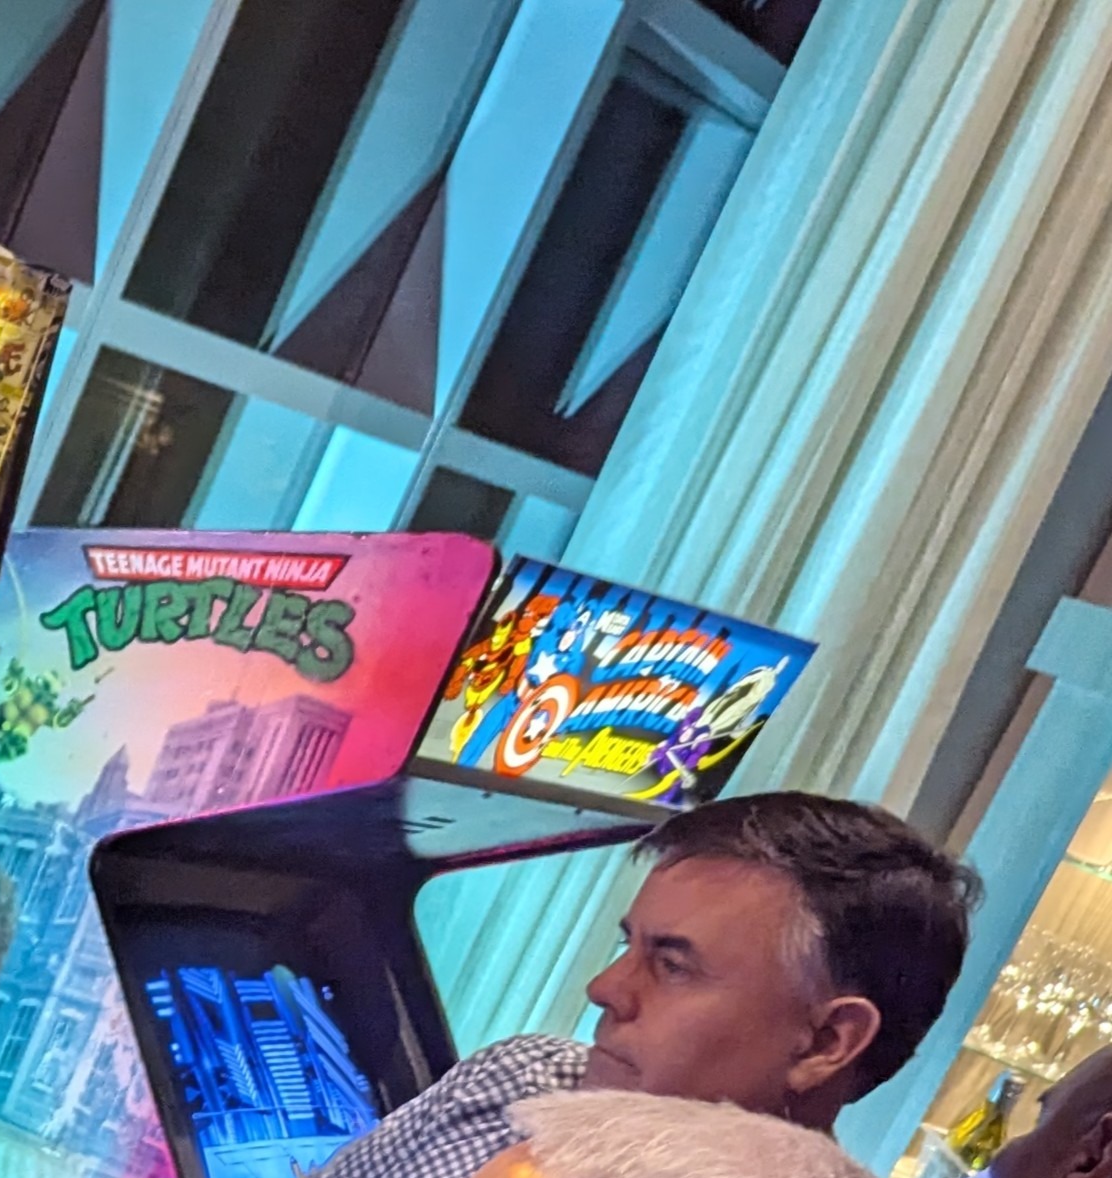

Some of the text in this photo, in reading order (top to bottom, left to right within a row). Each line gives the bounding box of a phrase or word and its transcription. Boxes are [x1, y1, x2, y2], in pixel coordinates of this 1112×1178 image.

[88, 552, 334, 583] TEENAGE MUTANT NINJA
[39, 577, 356, 683] TURTLES
